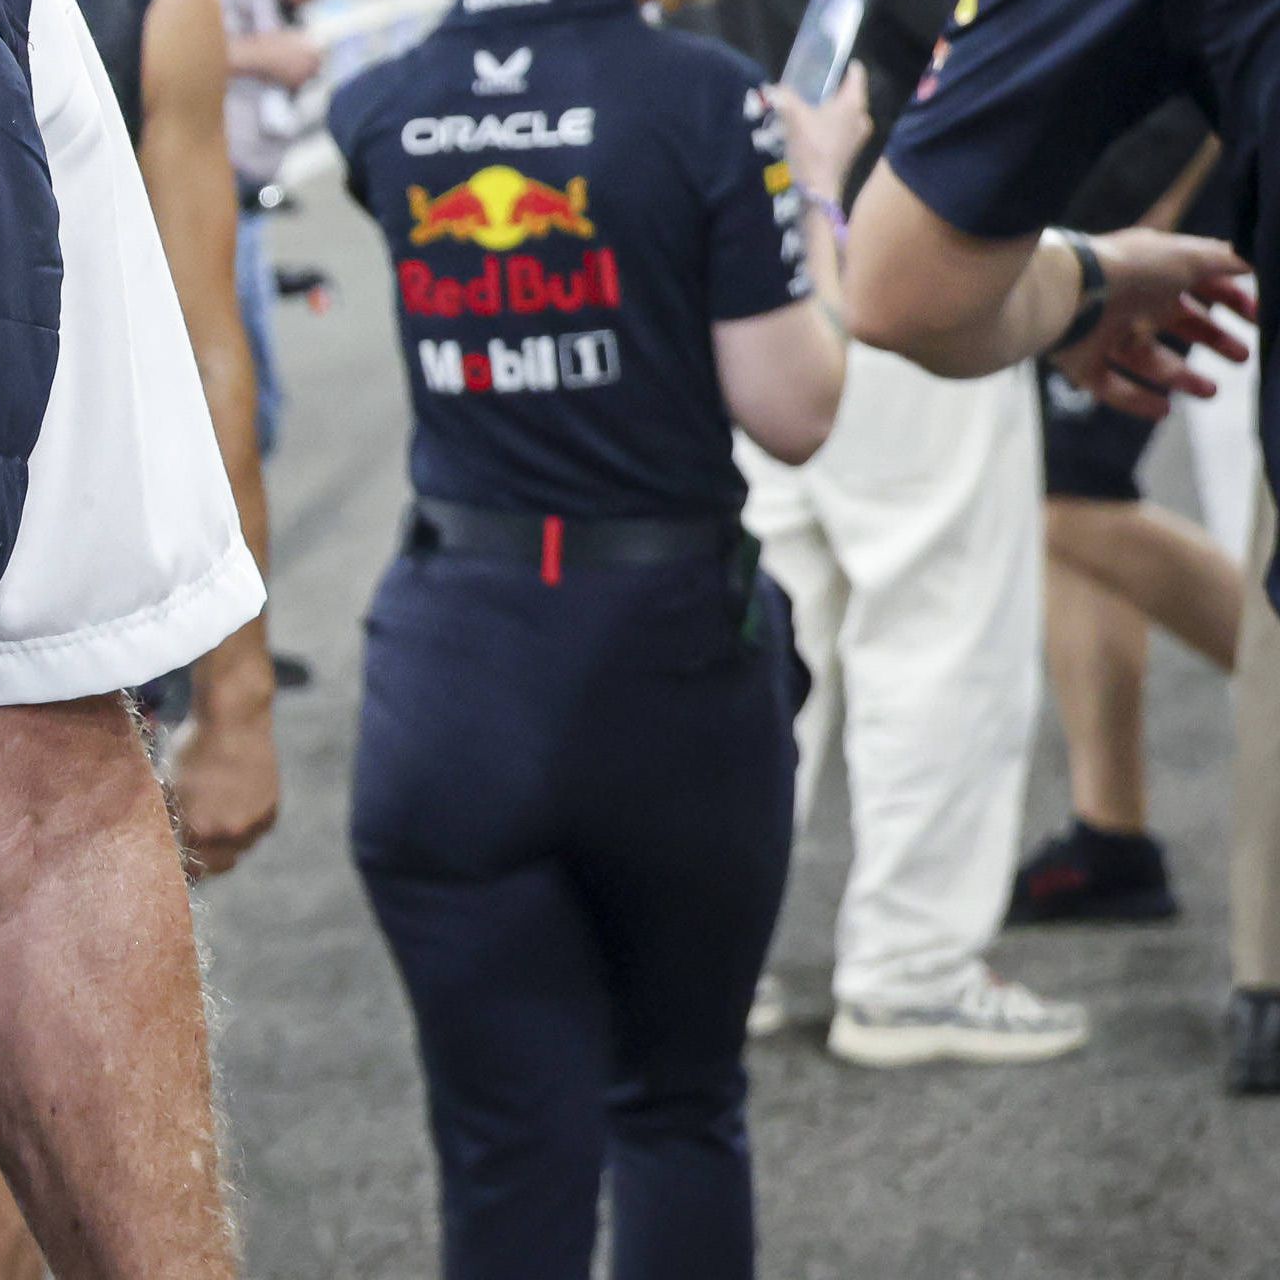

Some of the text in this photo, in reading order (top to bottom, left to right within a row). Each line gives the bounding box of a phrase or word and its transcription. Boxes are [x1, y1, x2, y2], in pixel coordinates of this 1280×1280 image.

[401, 107, 596, 156] ORACLE
[397, 247, 621, 318] Red Bull
[418, 334, 558, 394] Mobil
